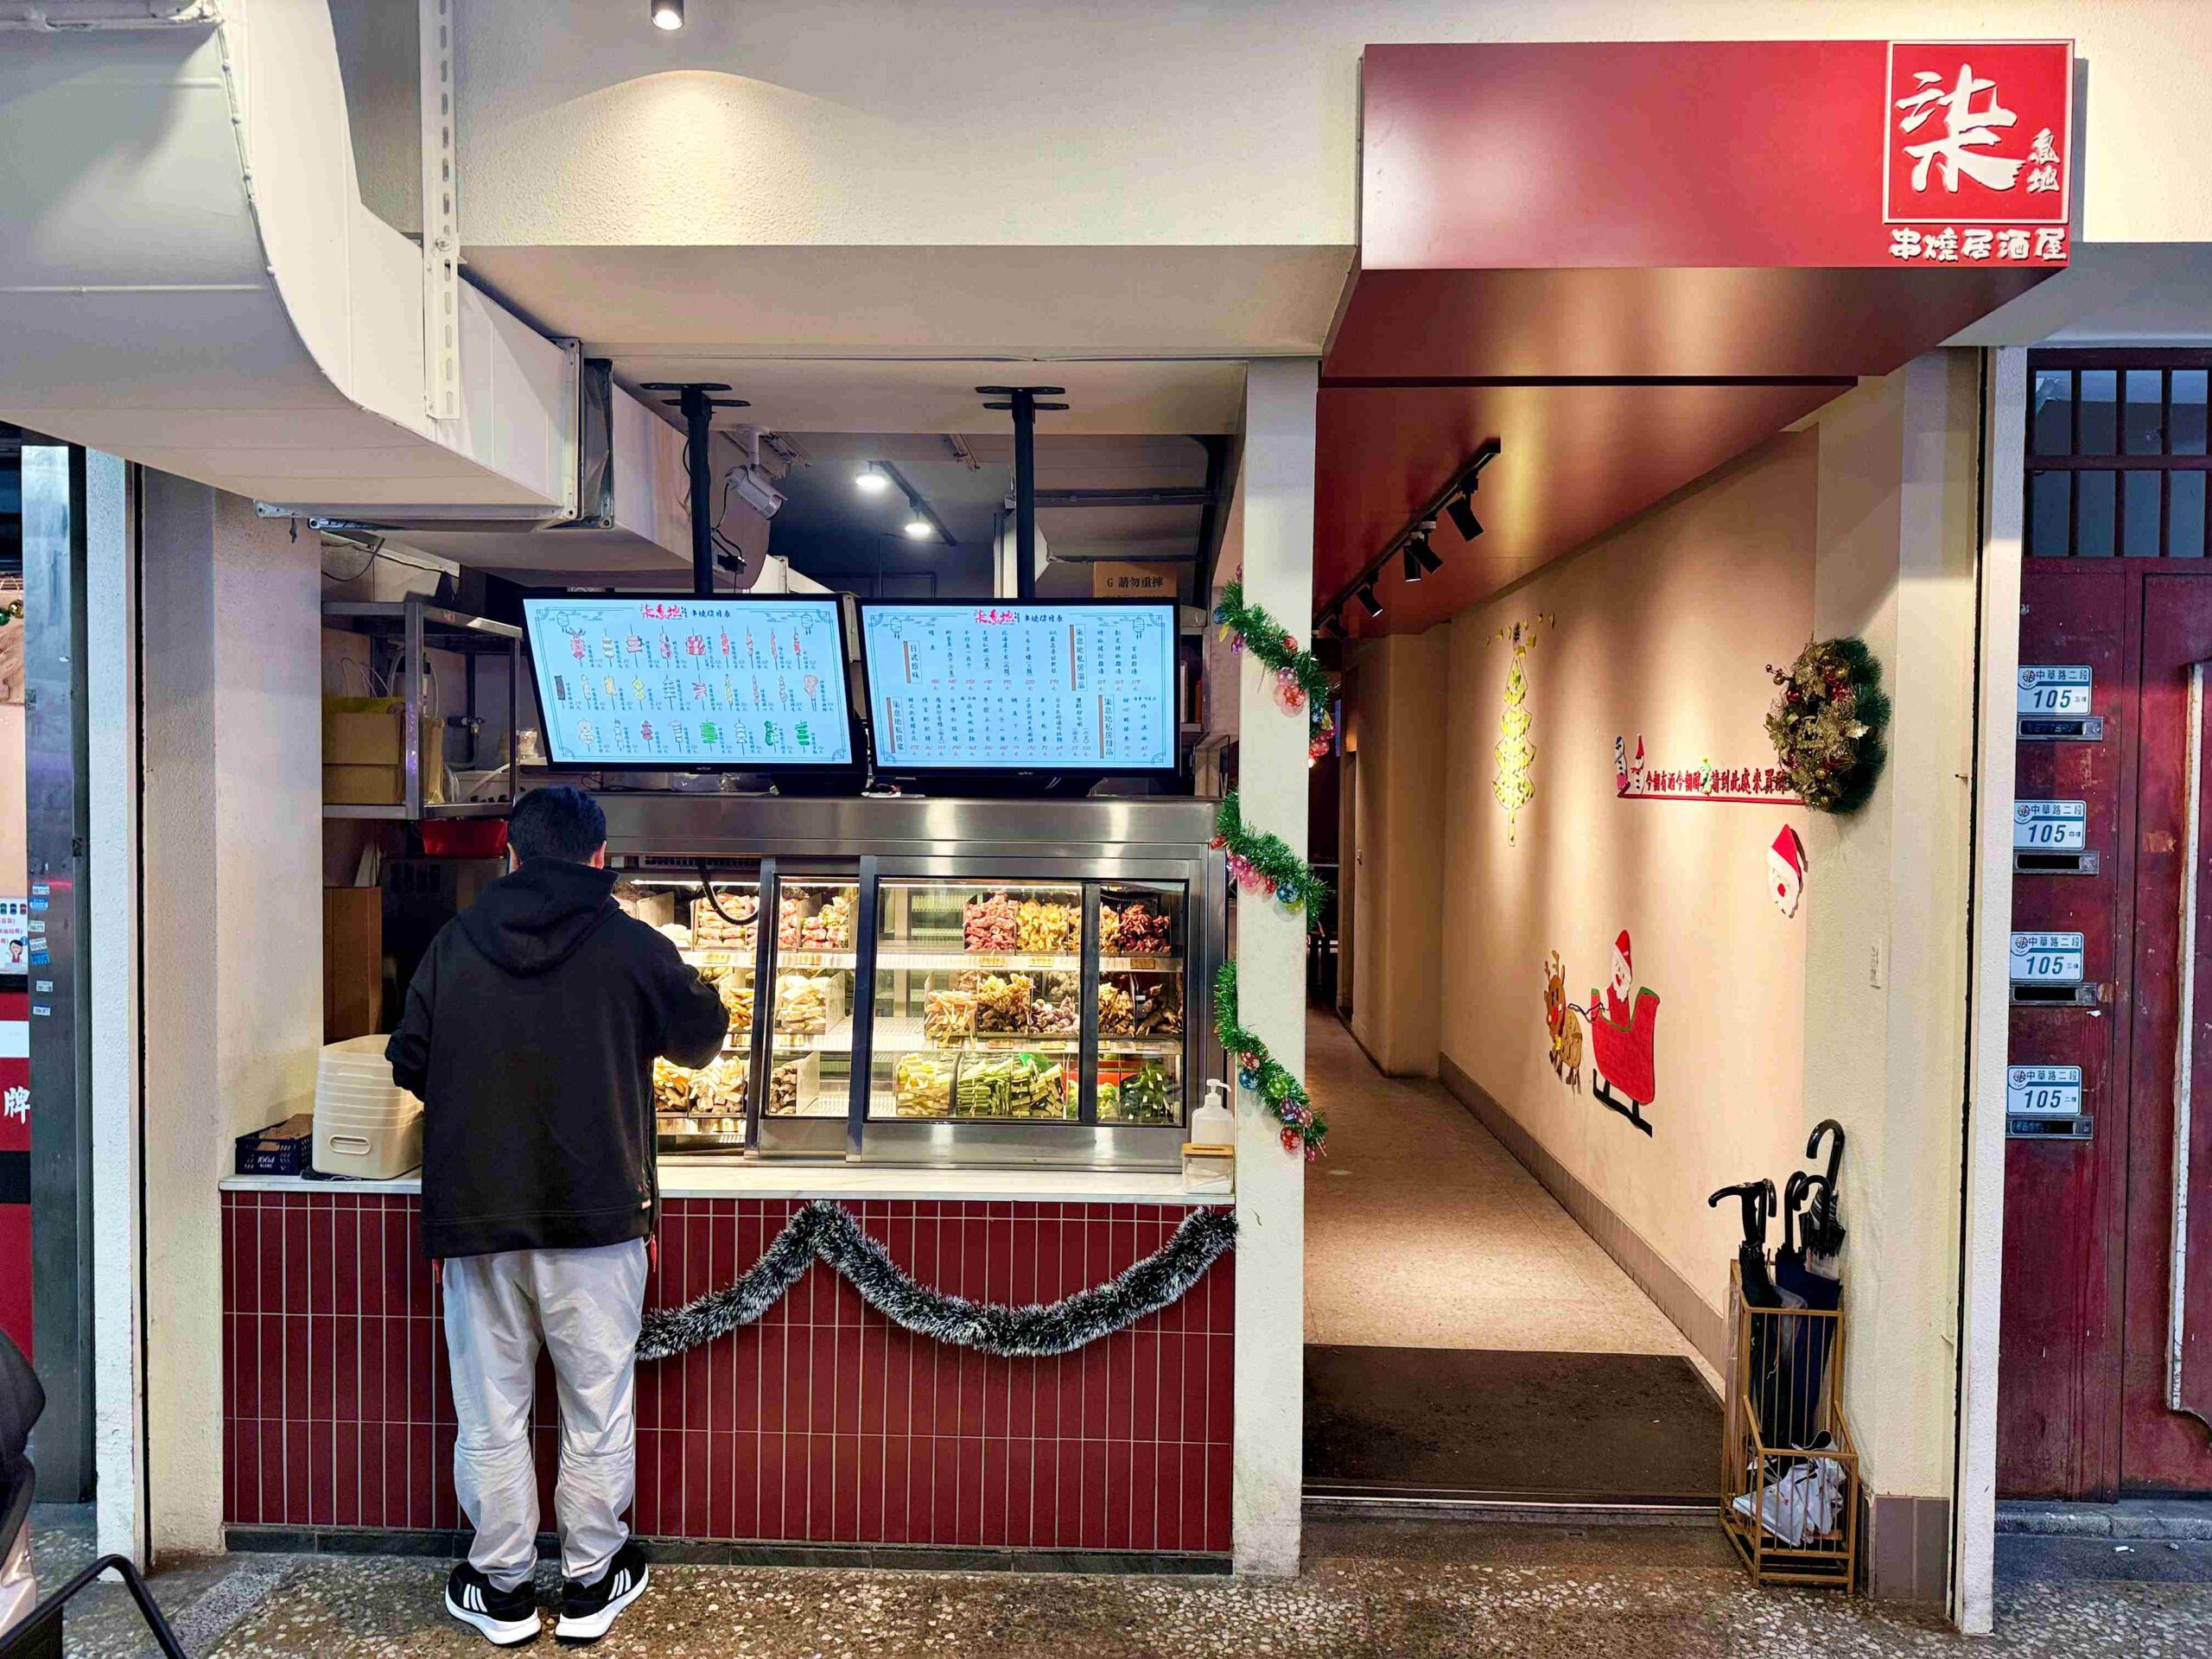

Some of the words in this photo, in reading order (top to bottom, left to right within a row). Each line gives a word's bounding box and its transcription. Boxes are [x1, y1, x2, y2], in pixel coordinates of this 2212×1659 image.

[1889, 227, 2068, 263] 串燒居酒屋
[1118, 576, 1163, 588] 請勿重摔
[2036, 670, 2088, 680] 中華路二段
[2034, 690, 2072, 709] 105
[2031, 804, 2082, 815] 中華路二段
[2029, 824, 2066, 842] 105
[2029, 937, 2080, 947] 中華路二段
[2026, 956, 2064, 975] 105
[2026, 1070, 2077, 1081] 中華路二段
[4, 1086, 30, 1124] 牌
[2024, 1090, 2062, 1109] 105
